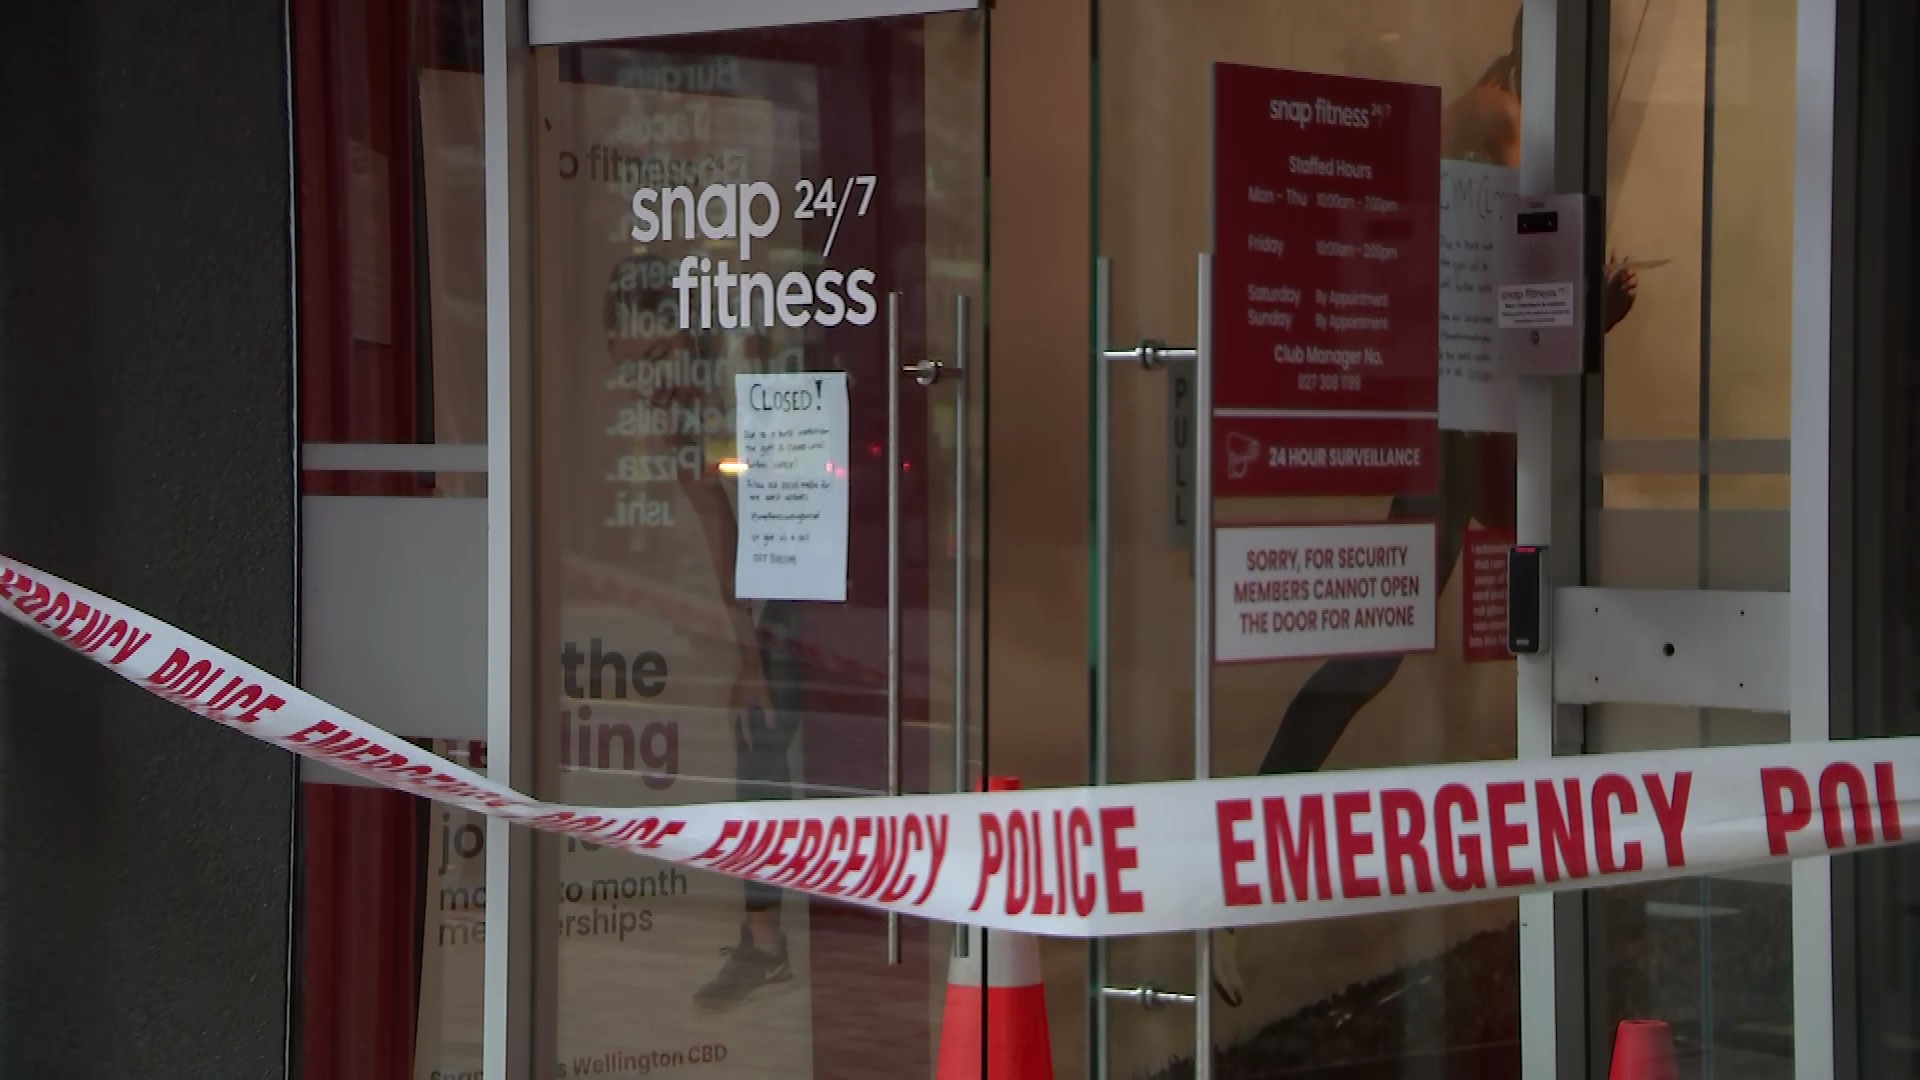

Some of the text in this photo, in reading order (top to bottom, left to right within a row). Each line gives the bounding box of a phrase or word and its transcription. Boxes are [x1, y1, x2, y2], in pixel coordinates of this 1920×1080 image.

[1269, 99, 1312, 131] snap
[1314, 96, 1370, 129] fitness
[1287, 155, 1374, 181] Staffed Hours
[1247, 186, 1274, 205] Mon
[1286, 188, 1308, 208] Thu
[631, 175, 877, 261] snap 24/7
[1247, 234, 1285, 260] Friday
[671, 256, 877, 329] fitness
[1247, 285, 1389, 310] Saturday By Appointment
[1247, 309, 1389, 333] Sunday By Appointment
[1273, 344, 1385, 371] Club Manager No.
[1173, 376, 1188, 526] PULL
[1269, 447, 1420, 467] 24 HOUR SURVEILLANCE
[1246, 546, 1408, 573] SORRY, FOR SECURITY
[1233, 576, 1419, 605] MEMBERS CANNOT OPEN
[1240, 604, 1415, 635] THE DOOR FOR ANYONE
[561, 638, 668, 699] the
[0, 567, 152, 666] ERGENCY
[690, 813, 950, 905] EMERGENCY
[968, 804, 1145, 918] POLICE
[1215, 770, 1692, 907] EMERGENCY
[591, 868, 688, 901] month
[573, 1050, 683, 1077] Wellington
[687, 1042, 728, 1065] CBD
